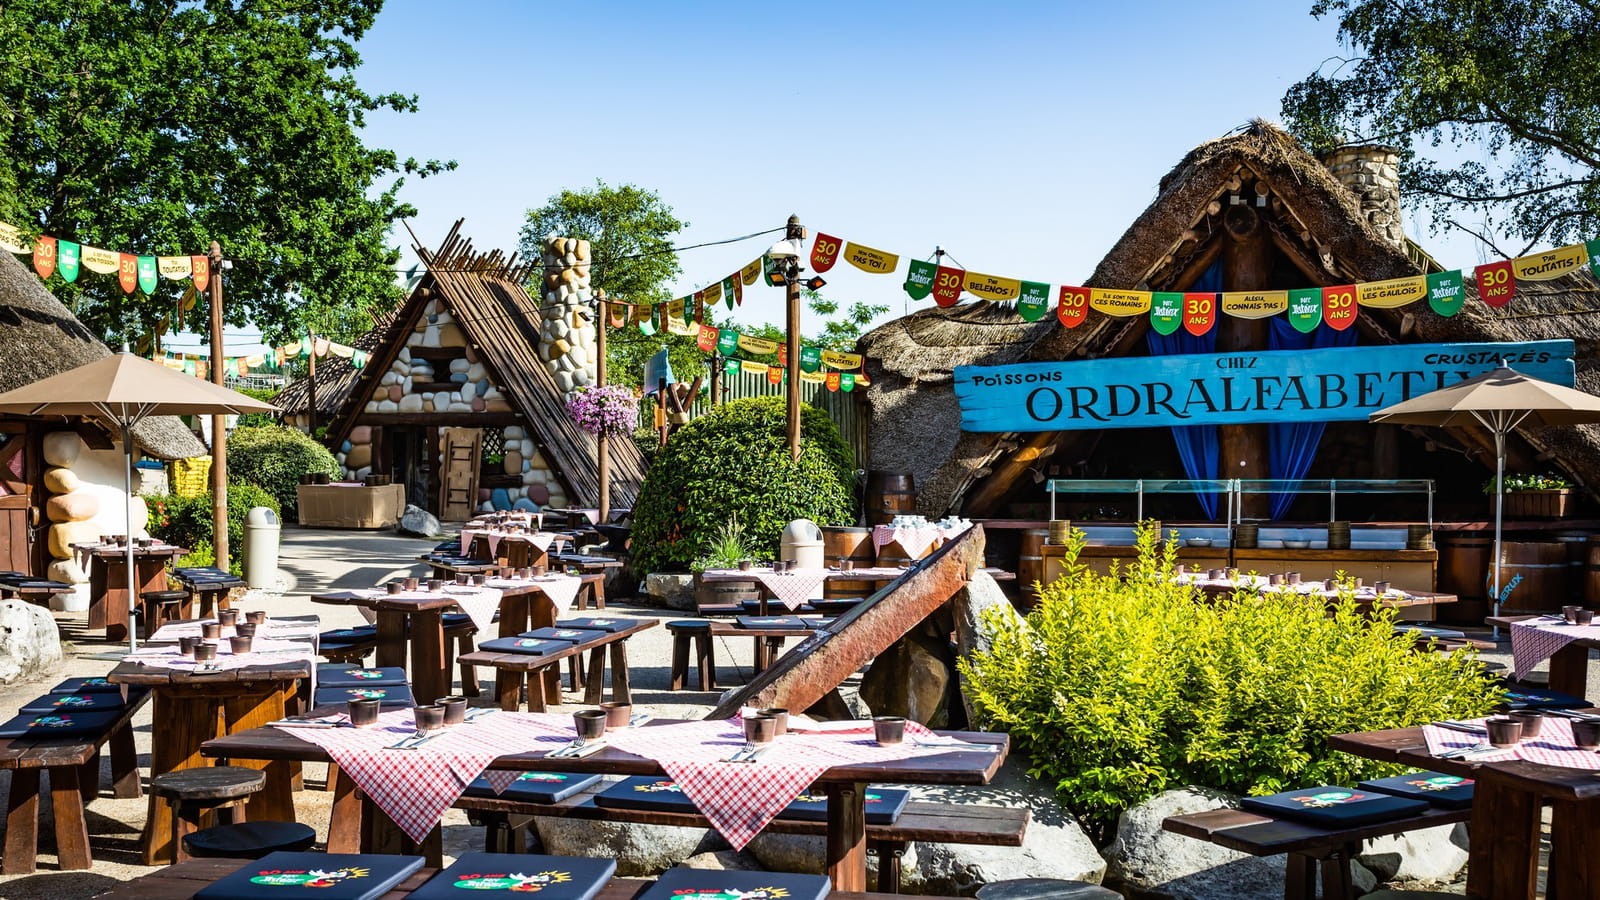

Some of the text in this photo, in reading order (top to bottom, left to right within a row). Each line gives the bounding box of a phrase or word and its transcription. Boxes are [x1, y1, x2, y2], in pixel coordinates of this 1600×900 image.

[37, 242, 53, 258] 30
[816, 240, 836, 256] 30
[38, 259, 51, 268] ANS
[814, 256, 831, 265] ANS
[853, 255, 867, 265] PAS
[121, 260, 136, 274] 30
[194, 261, 206, 273] 30
[1520, 257, 1574, 277] TOUTATIS
[938, 273, 960, 289] 30
[1482, 268, 1509, 287] 30
[937, 289, 955, 298] ANS
[969, 282, 1009, 296] BELENOS
[1362, 291, 1378, 300] LES
[1379, 286, 1417, 298] GAULOIS
[1486, 286, 1509, 298] ANS
[1062, 292, 1085, 308] 30
[1327, 292, 1352, 309] 30
[1062, 309, 1081, 318] ANS
[1187, 299, 1211, 315] 30
[1226, 303, 1262, 311] CONNAIS
[1189, 316, 1209, 325] ANS
[1329, 309, 1350, 319] ANS
[702, 329, 716, 340] 30
[827, 357, 853, 366] TOUTATIS
[1215, 356, 1258, 370] CHEZ
[1423, 350, 1552, 366] CRUSTACÉS
[771, 368, 781, 376] 30
